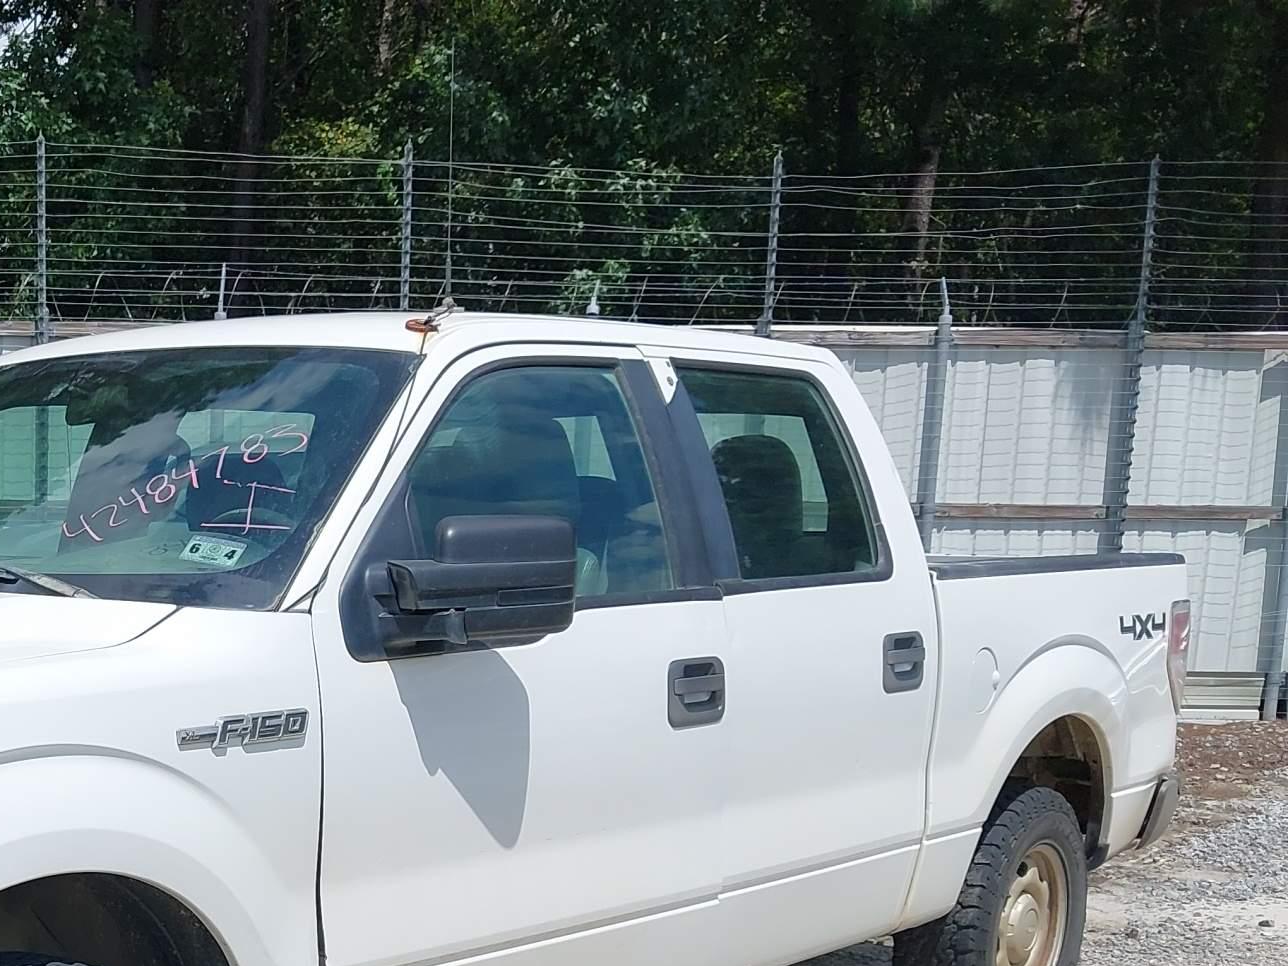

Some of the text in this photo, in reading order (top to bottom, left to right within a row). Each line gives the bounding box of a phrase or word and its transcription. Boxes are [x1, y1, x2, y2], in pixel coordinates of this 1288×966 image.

[62, 424, 308, 541] 42484783
[189, 543, 202, 554] 6
[223, 549, 238, 560] 4
[213, 708, 310, 754] F-150
